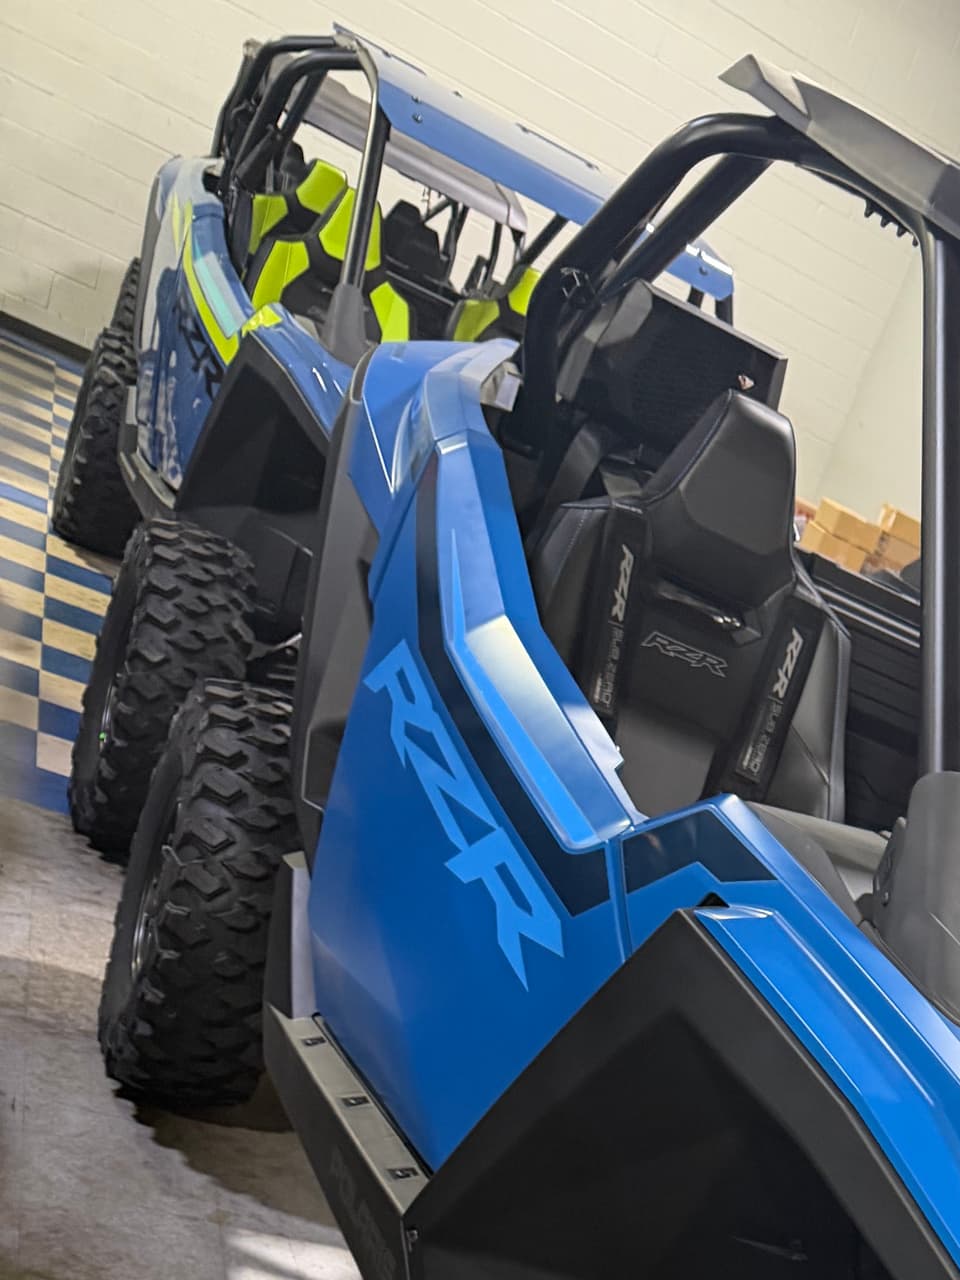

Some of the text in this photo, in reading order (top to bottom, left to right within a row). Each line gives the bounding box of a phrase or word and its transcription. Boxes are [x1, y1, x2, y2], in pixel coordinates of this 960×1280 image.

[611, 544, 635, 622] RZR
[640, 630, 729, 678] RZR
[773, 626, 805, 699] RZR
[363, 638, 565, 993] RZR
